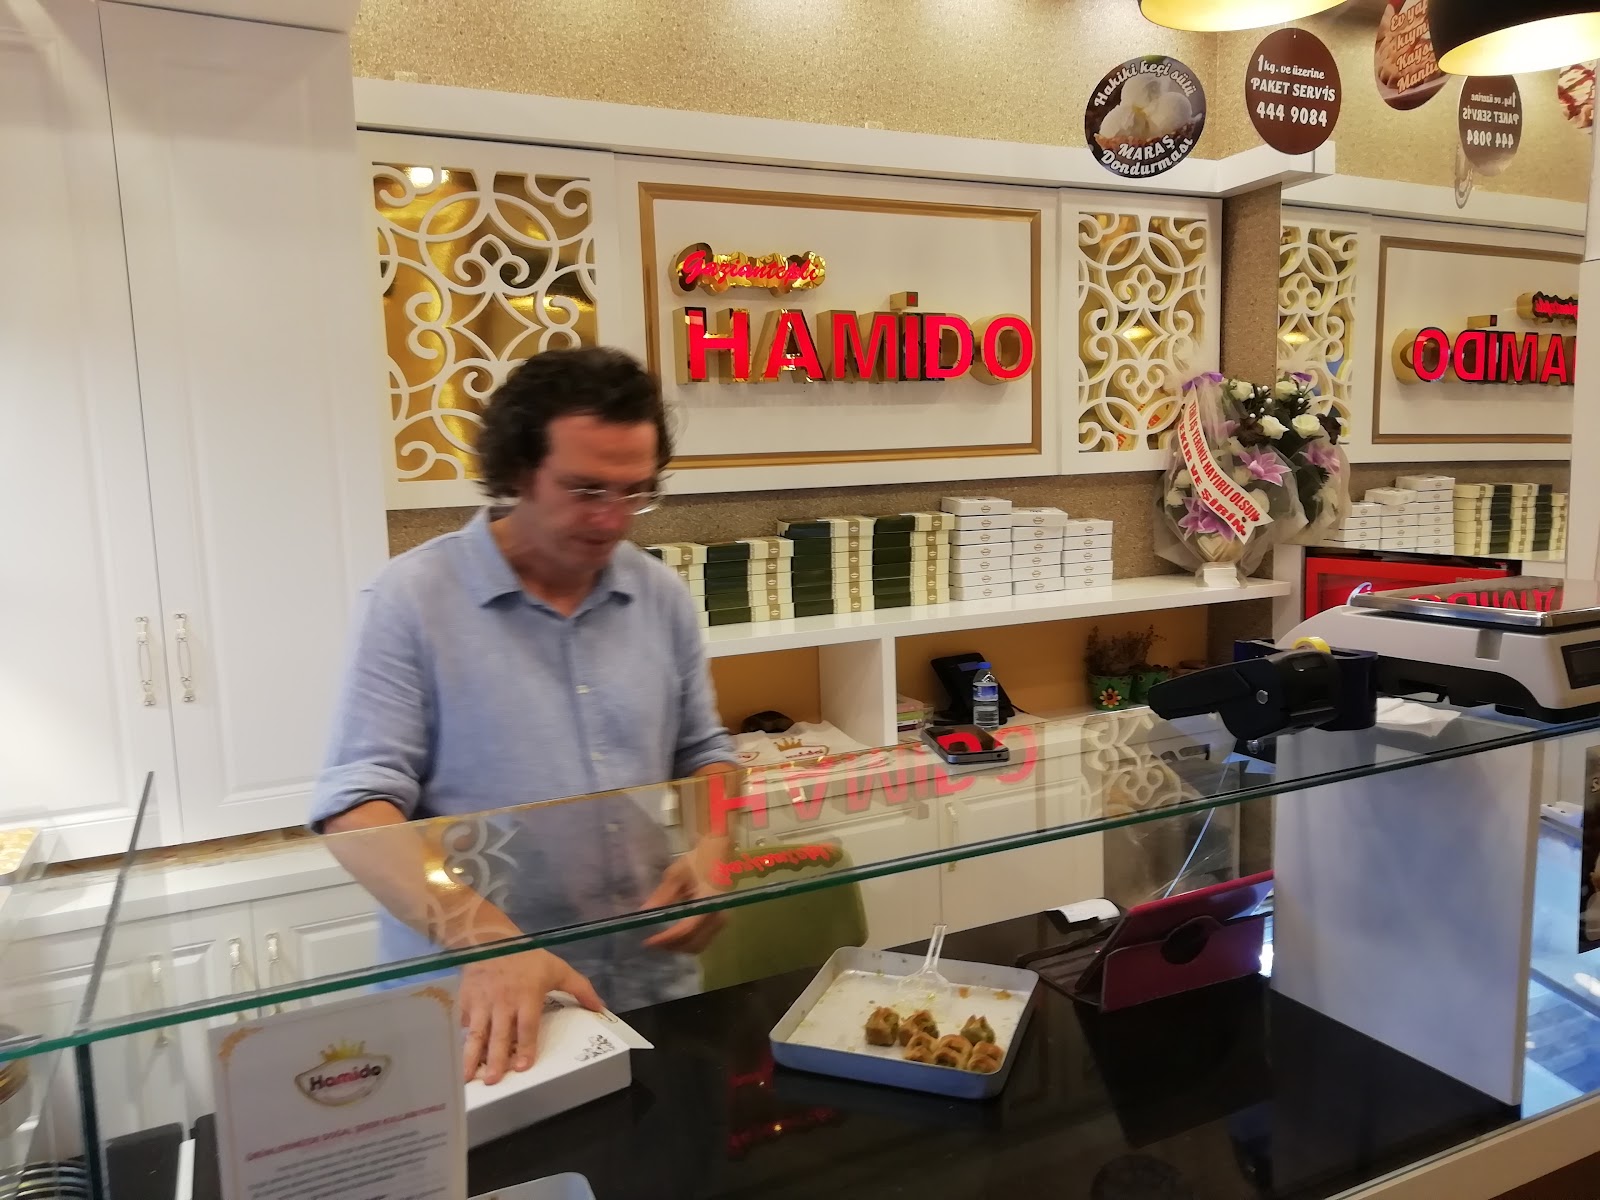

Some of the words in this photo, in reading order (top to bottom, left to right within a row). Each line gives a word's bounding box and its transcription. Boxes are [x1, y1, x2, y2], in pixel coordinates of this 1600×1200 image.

[1094, 64, 1138, 107] Hakiki
[1140, 60, 1171, 77] keçi
[1170, 71, 1197, 97] sütü
[1251, 78, 1290, 95] PAKET
[1292, 85, 1336, 102] SERVİS
[1281, 65, 1292, 75] ve
[1293, 65, 1325, 80] üzerine
[1256, 101, 1285, 121] 444
[1290, 106, 1328, 127] 9084
[1101, 138, 1193, 176] Dondurması
[1117, 135, 1176, 160] MARAŞ
[682, 249, 820, 287] Gaziantepli
[685, 291, 1035, 383] HAMİDO
[1202, 461, 1234, 497] HAYIRLI
[1229, 491, 1260, 522] OLSUN
